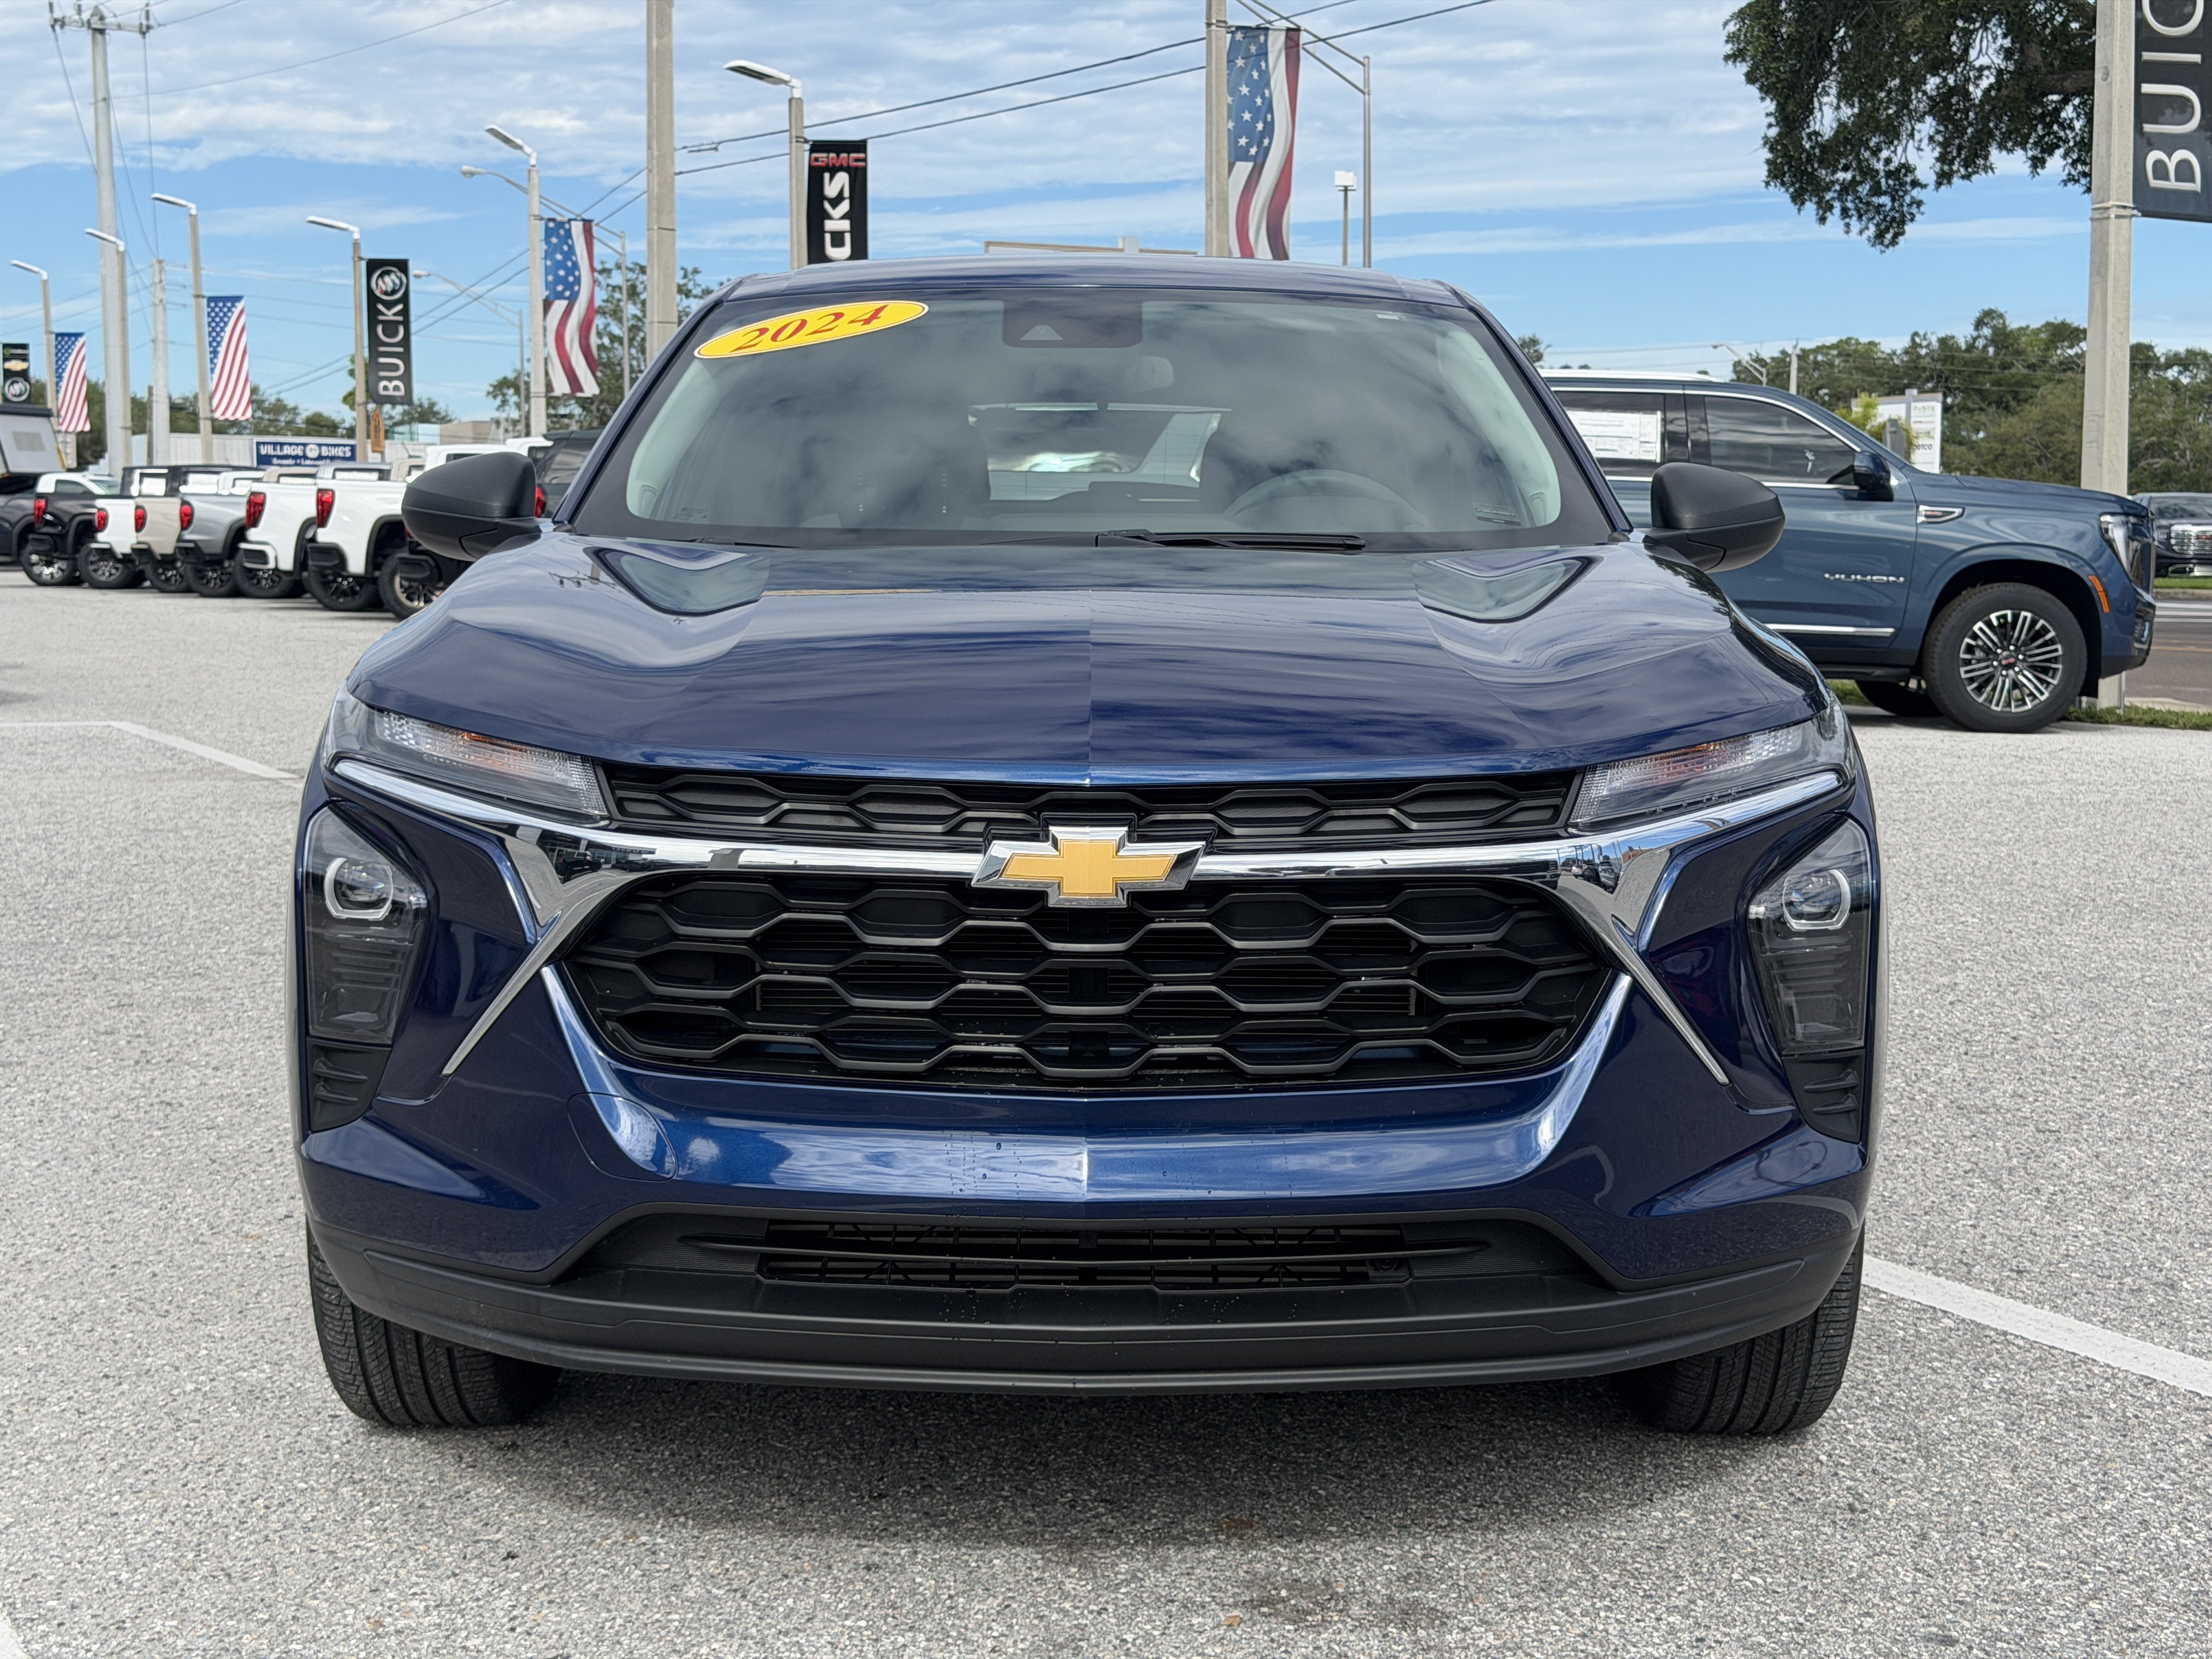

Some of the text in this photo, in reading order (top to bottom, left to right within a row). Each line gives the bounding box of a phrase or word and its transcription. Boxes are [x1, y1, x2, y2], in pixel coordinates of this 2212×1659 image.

[810, 153, 866, 167] GMC
[729, 304, 891, 353] 2024
[376, 303, 405, 396] BUICK
[259, 444, 352, 457] VILLAGE BIKES
